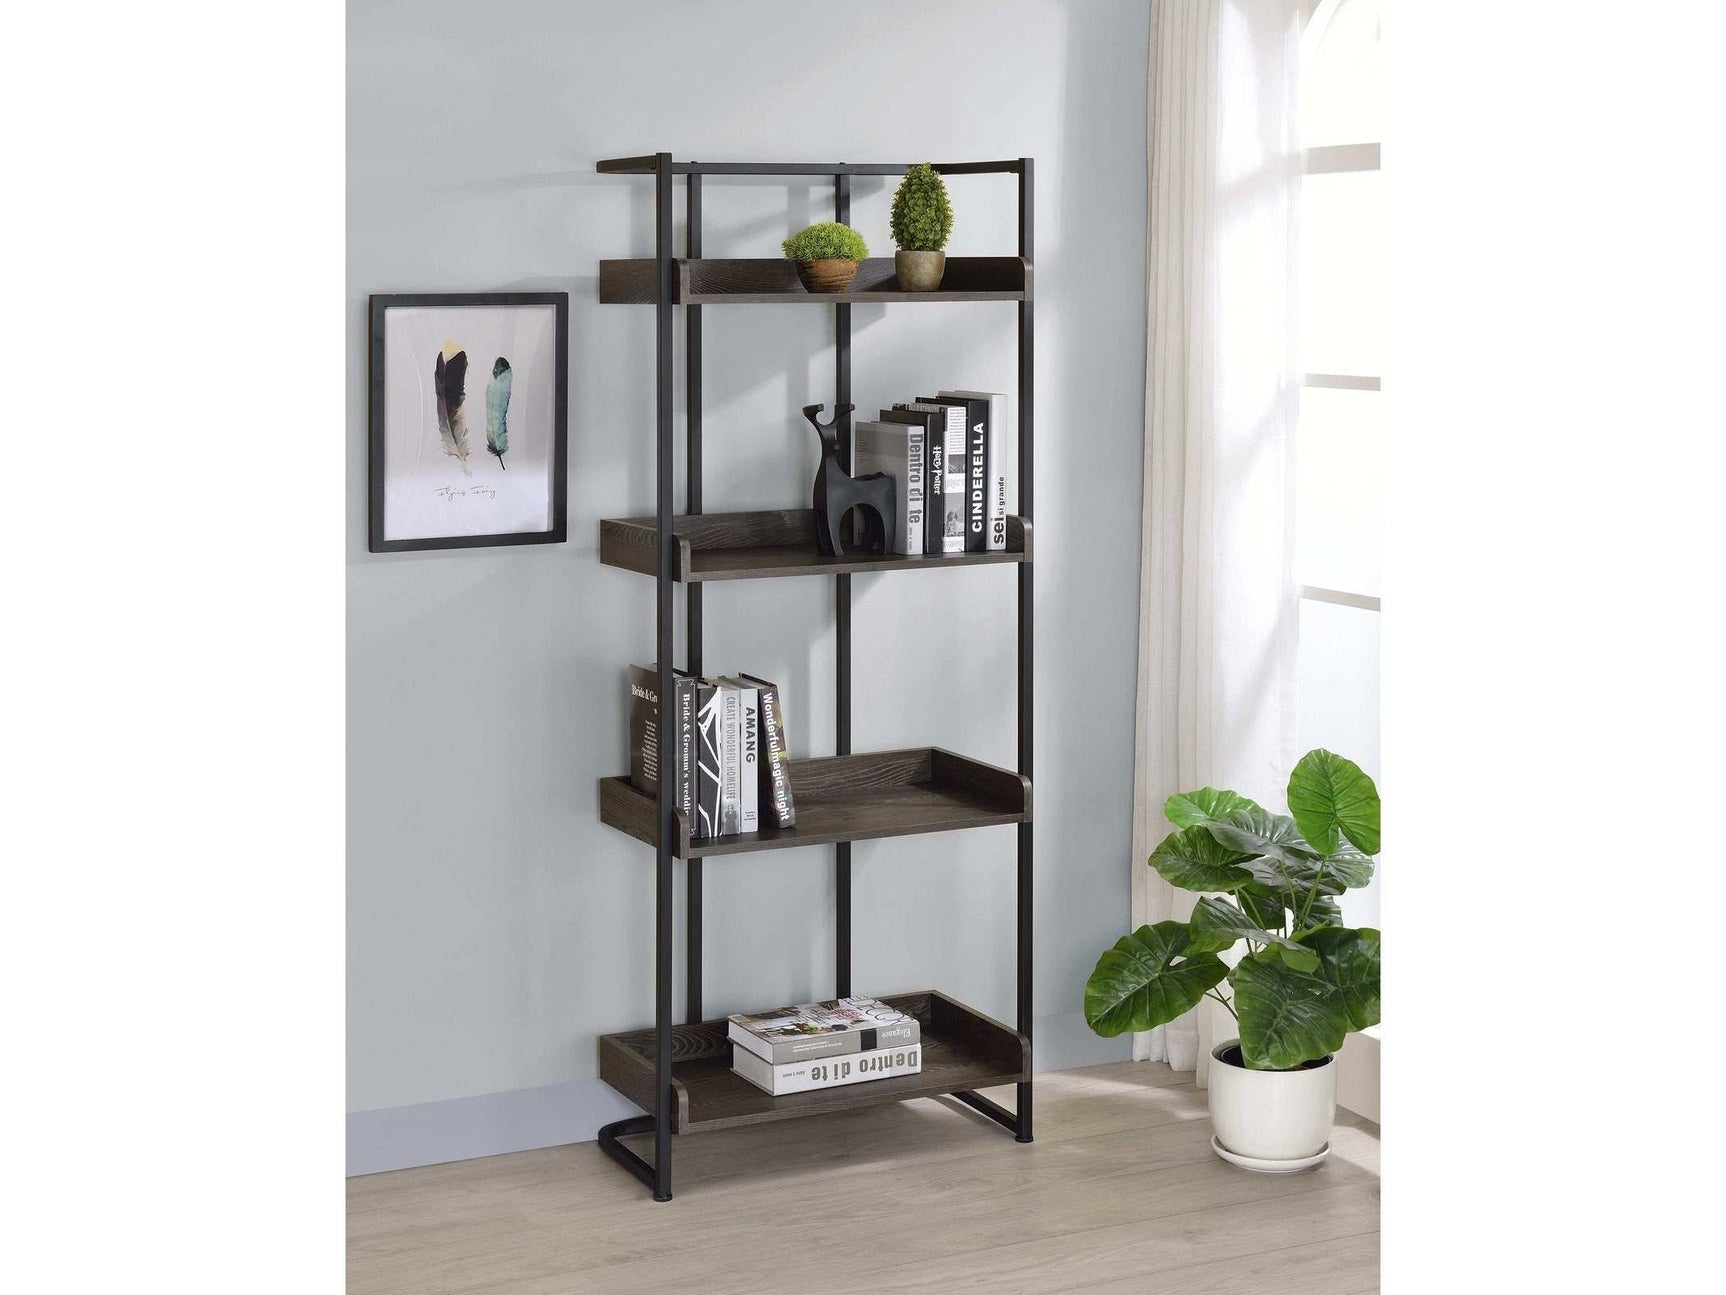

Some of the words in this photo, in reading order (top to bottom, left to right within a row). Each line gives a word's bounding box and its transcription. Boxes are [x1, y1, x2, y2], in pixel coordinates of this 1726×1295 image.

[909, 433, 923, 484] Dentro
[932, 445, 942, 469] Harry
[931, 469, 942, 495] Potter
[972, 422, 984, 533] CINDERELLA
[909, 487, 923, 502] di
[998, 476, 1006, 507] grande
[909, 509, 922, 524] te
[998, 508, 1004, 516] si
[990, 517, 1004, 544] sei
[631, 684, 645, 699] Bride
[683, 693, 691, 722] Bride
[726, 696, 736, 721] CREATE
[683, 723, 691, 732] &
[745, 707, 755, 763] AMANG
[726, 722, 736, 765] WONDERFUL
[763, 692, 784, 788] Wonderfulmagic
[776, 790, 791, 821] night
[726, 766, 736, 800] HOMELIFE
[882, 1027, 912, 1039] Elegance
[811, 1065, 828, 1081] te
[834, 1061, 851, 1080] di
[859, 1050, 918, 1073] Dentro
